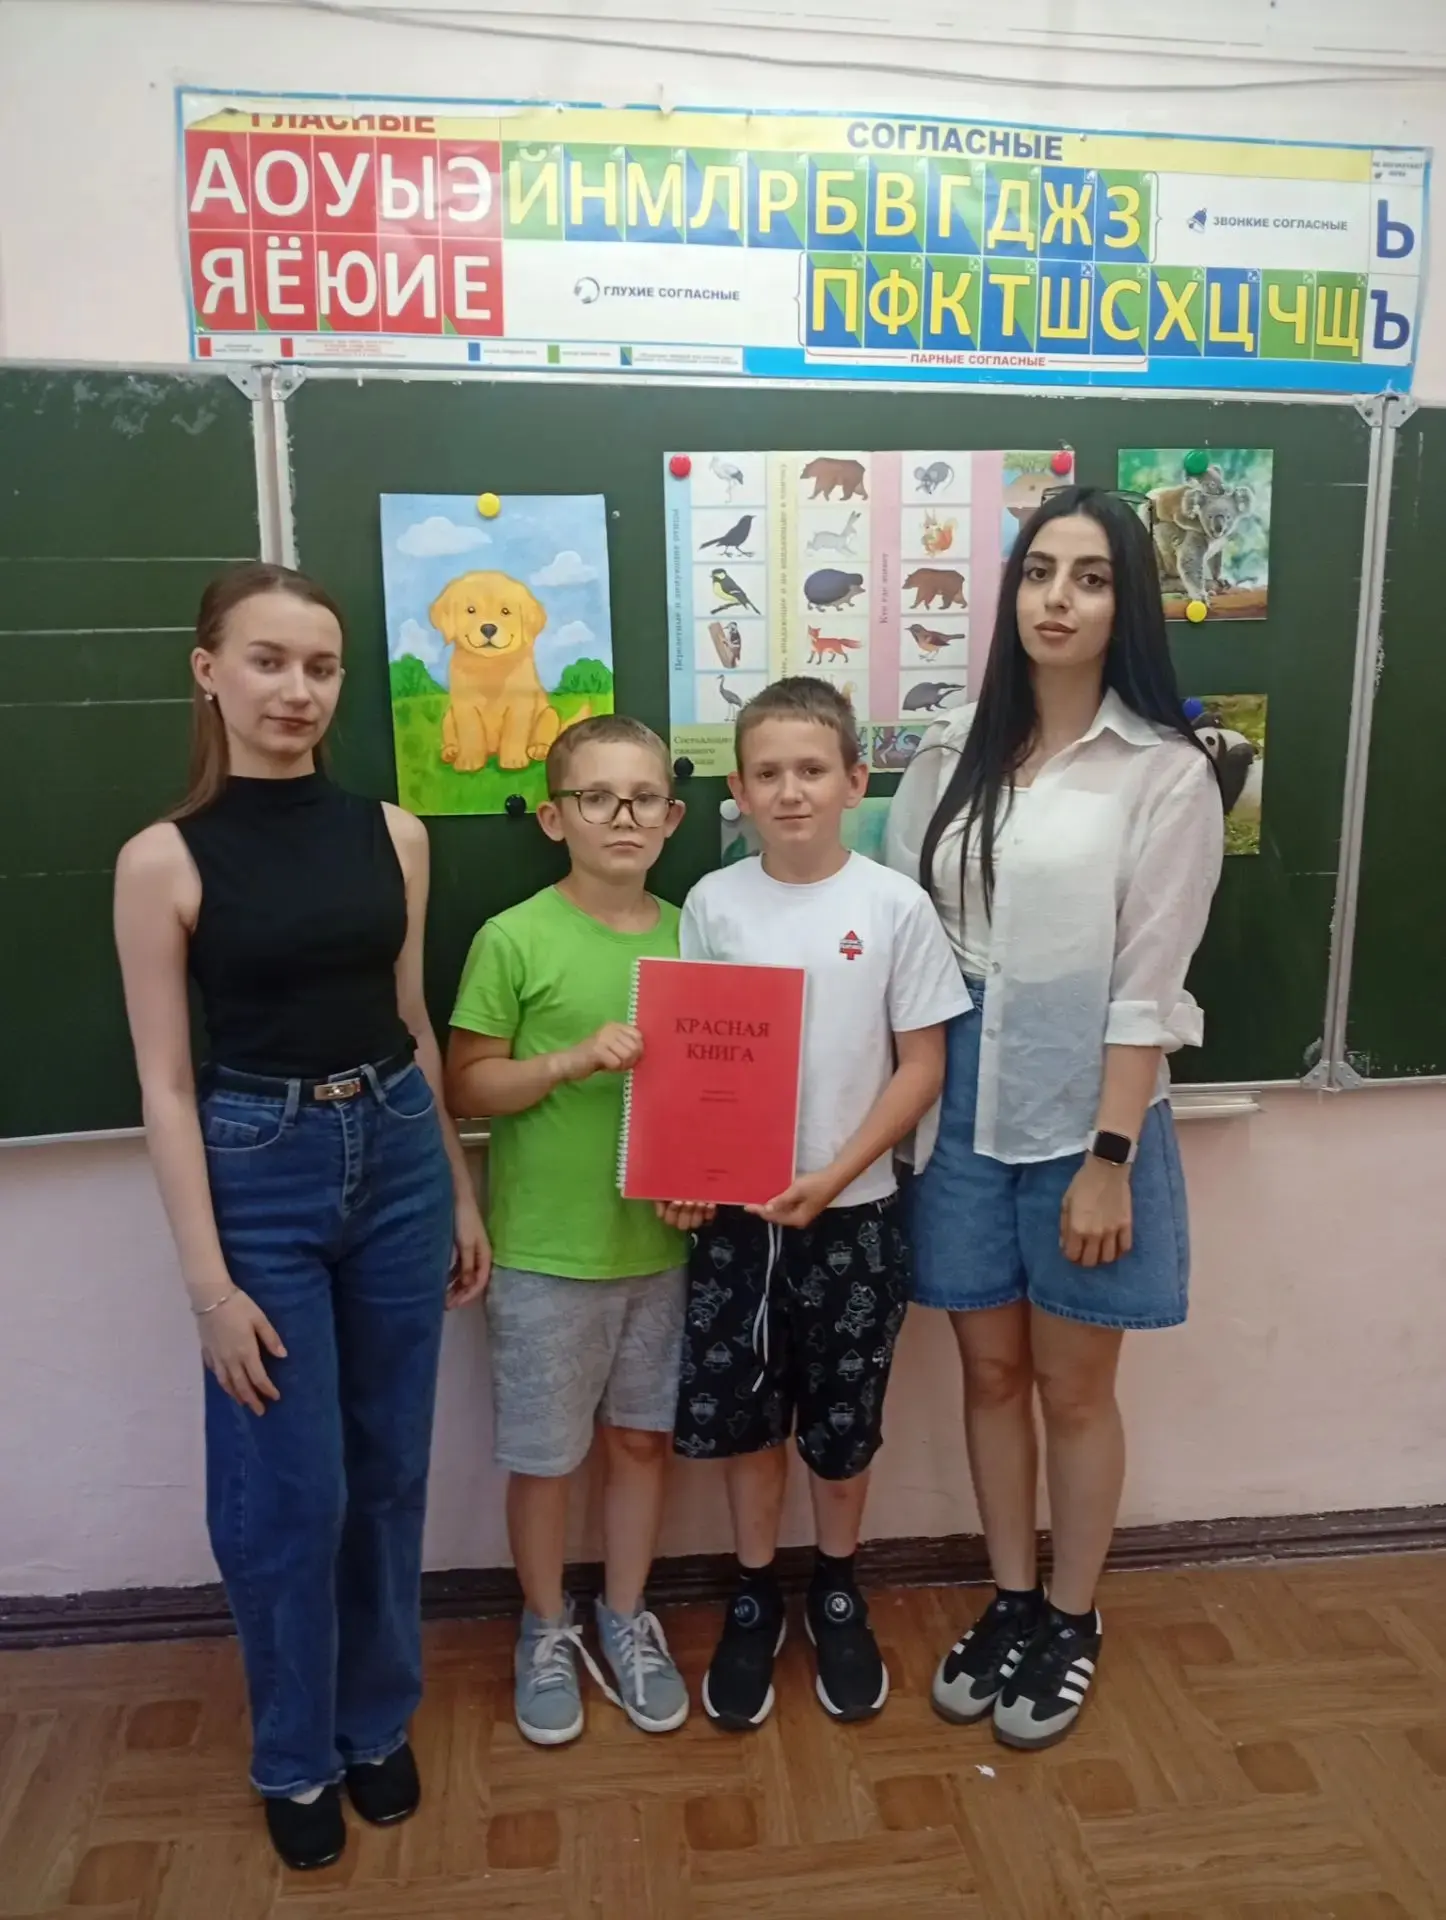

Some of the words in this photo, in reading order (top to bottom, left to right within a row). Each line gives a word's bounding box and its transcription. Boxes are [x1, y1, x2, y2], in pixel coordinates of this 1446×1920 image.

[847, 121, 1063, 161] СОГЛАСНЫЕ
[1213, 217, 1269, 228] ЗВОНКИЕ
[1273, 218, 1348, 230] СОГЛАСНЫЕ
[1377, 199, 1415, 258] Ь
[604, 286, 654, 297] ГЛУХИЕ
[658, 288, 740, 301] СОГЛАСНЫЕ
[1370, 289, 1410, 350] Ъ
[910, 354, 964, 365] ПАРНЫЕ
[969, 355, 1046, 366] СОГЛАСНЫЕ
[675, 1018, 770, 1038] КРАСНАЯ
[686, 1043, 754, 1063] КНИГА
